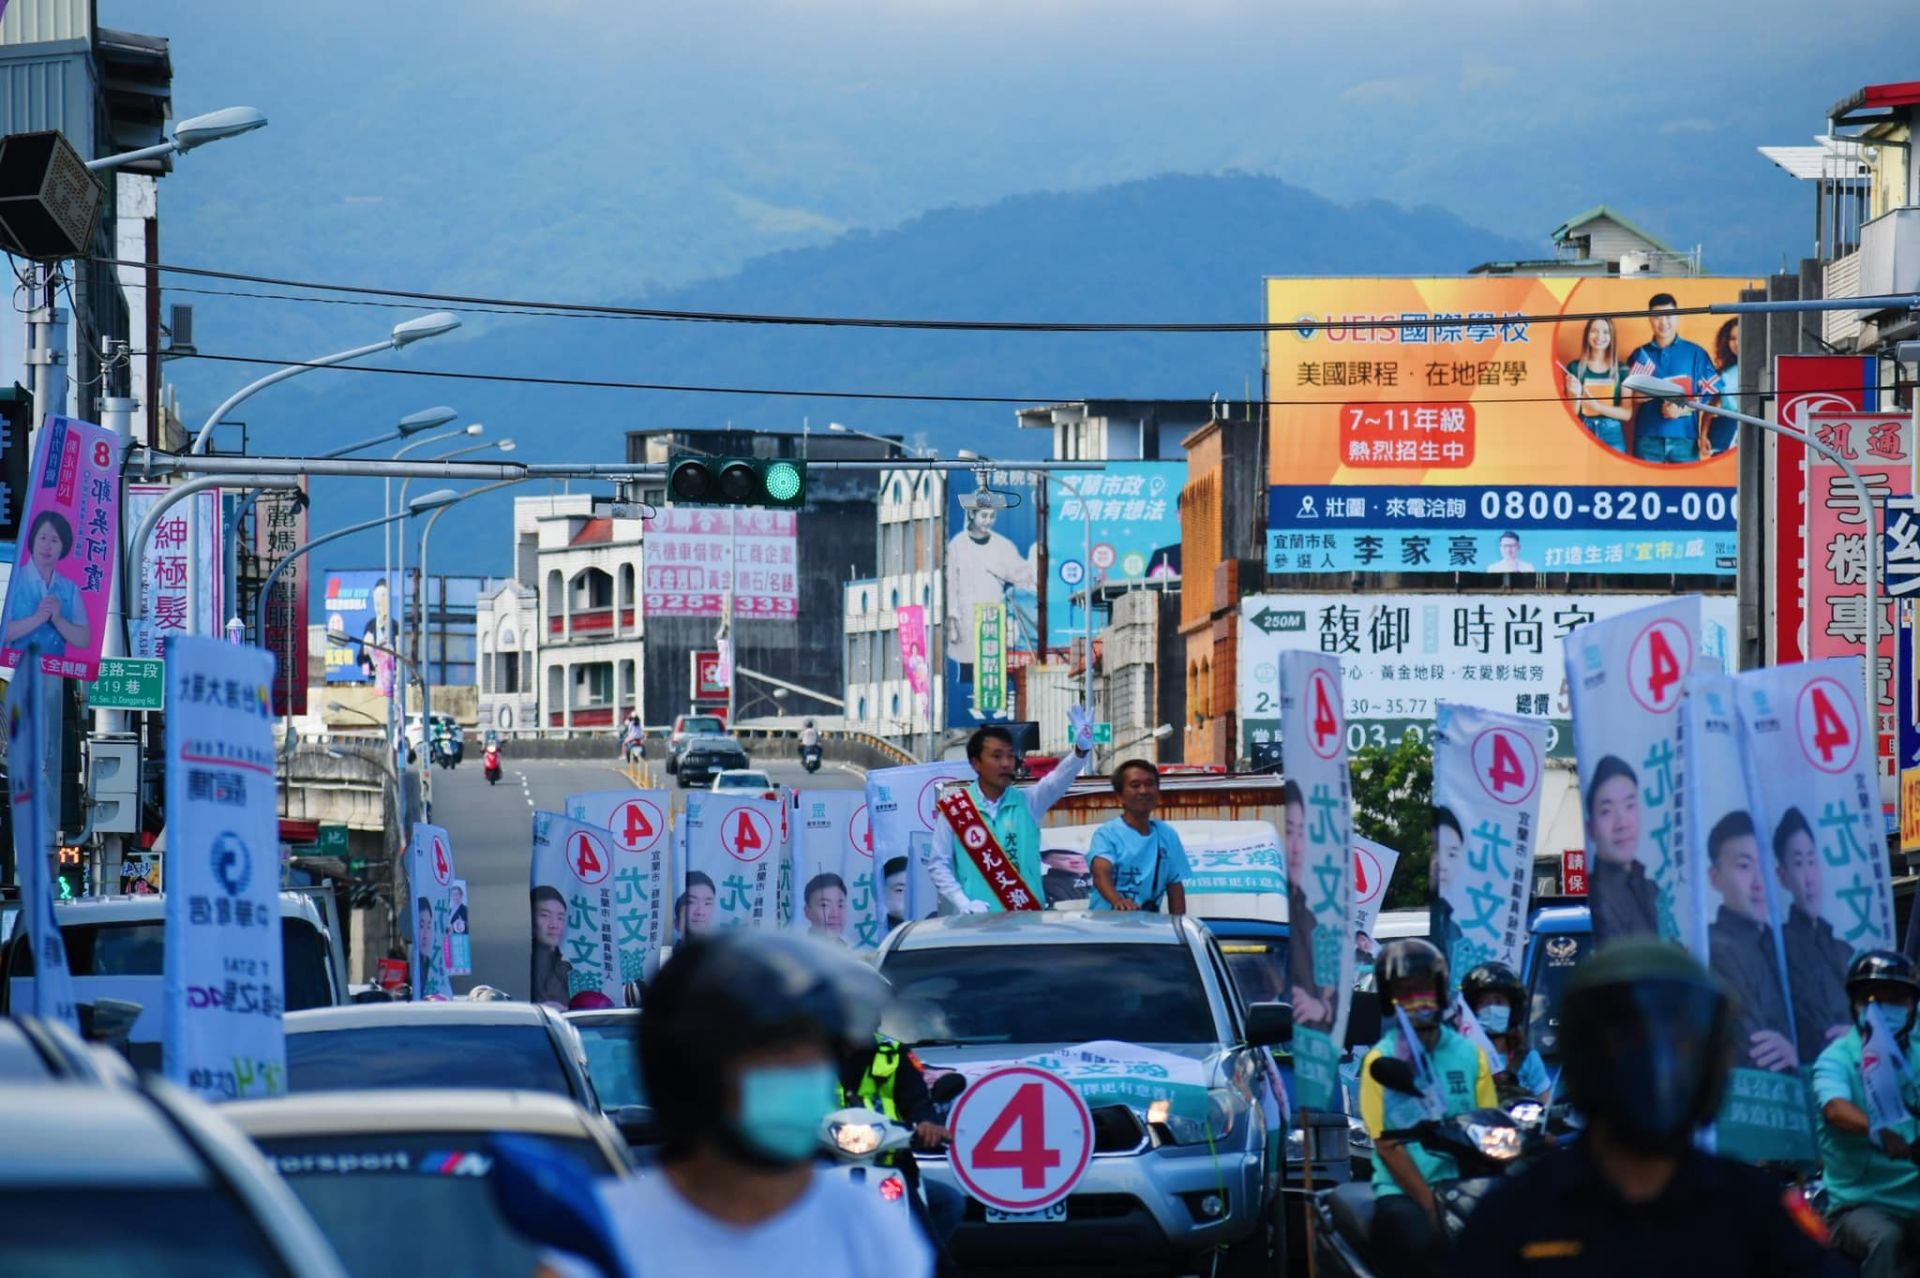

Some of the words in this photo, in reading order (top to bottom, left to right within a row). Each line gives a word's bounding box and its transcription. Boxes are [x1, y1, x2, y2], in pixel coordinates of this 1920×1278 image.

[1326, 313, 1529, 344] UEIS國際學校
[1349, 408, 1466, 432] 7~11年級
[1348, 440, 1465, 463] 熱烈招生中
[1057, 474, 1146, 496] 宜蘭市政
[1273, 533, 1337, 550] 宜蘭市長
[1353, 535, 1478, 567] 李家豪
[646, 593, 793, 612] 925-333
[1264, 615, 1300, 628] 250M
[1318, 604, 1410, 654] 馥御
[971, 1083, 1061, 1190] 4
